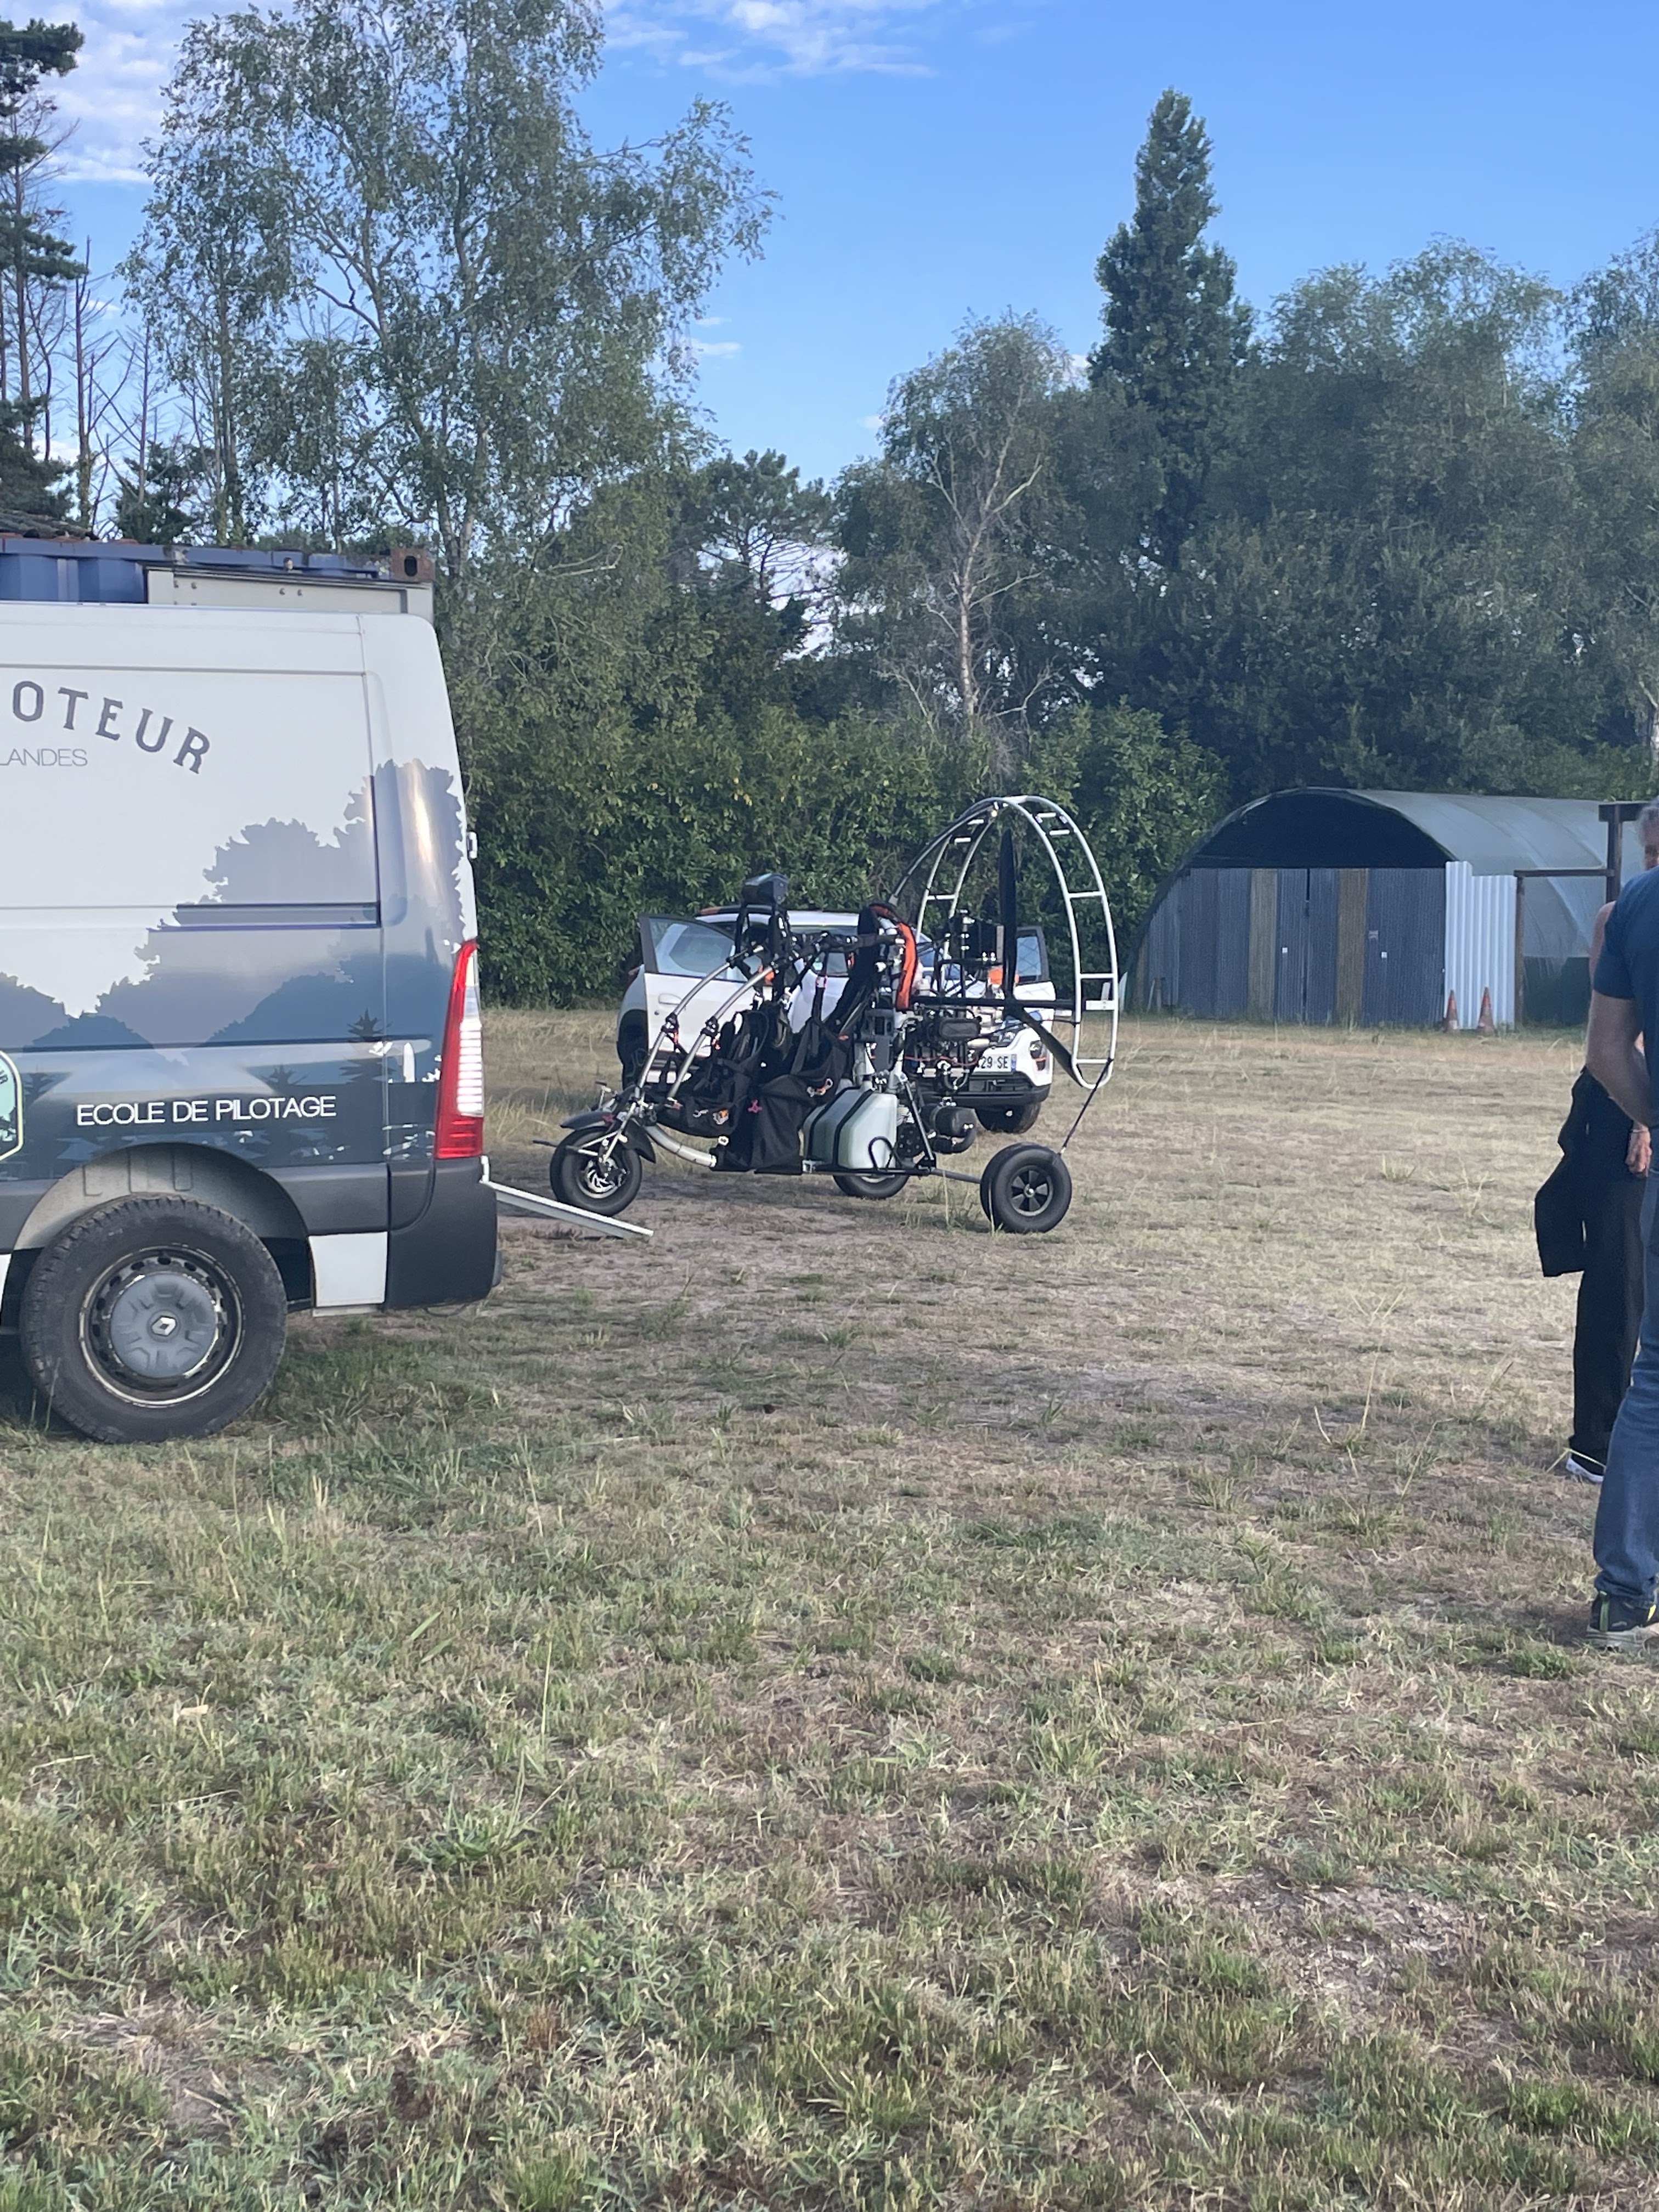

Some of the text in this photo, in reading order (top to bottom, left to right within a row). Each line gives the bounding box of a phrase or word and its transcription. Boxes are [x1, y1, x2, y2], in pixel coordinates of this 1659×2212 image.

[13, 680, 210, 774] OTEUR
[977, 1056, 992, 1069] 29
[77, 1096, 337, 1126] ECOLE DE PILOTAGE
